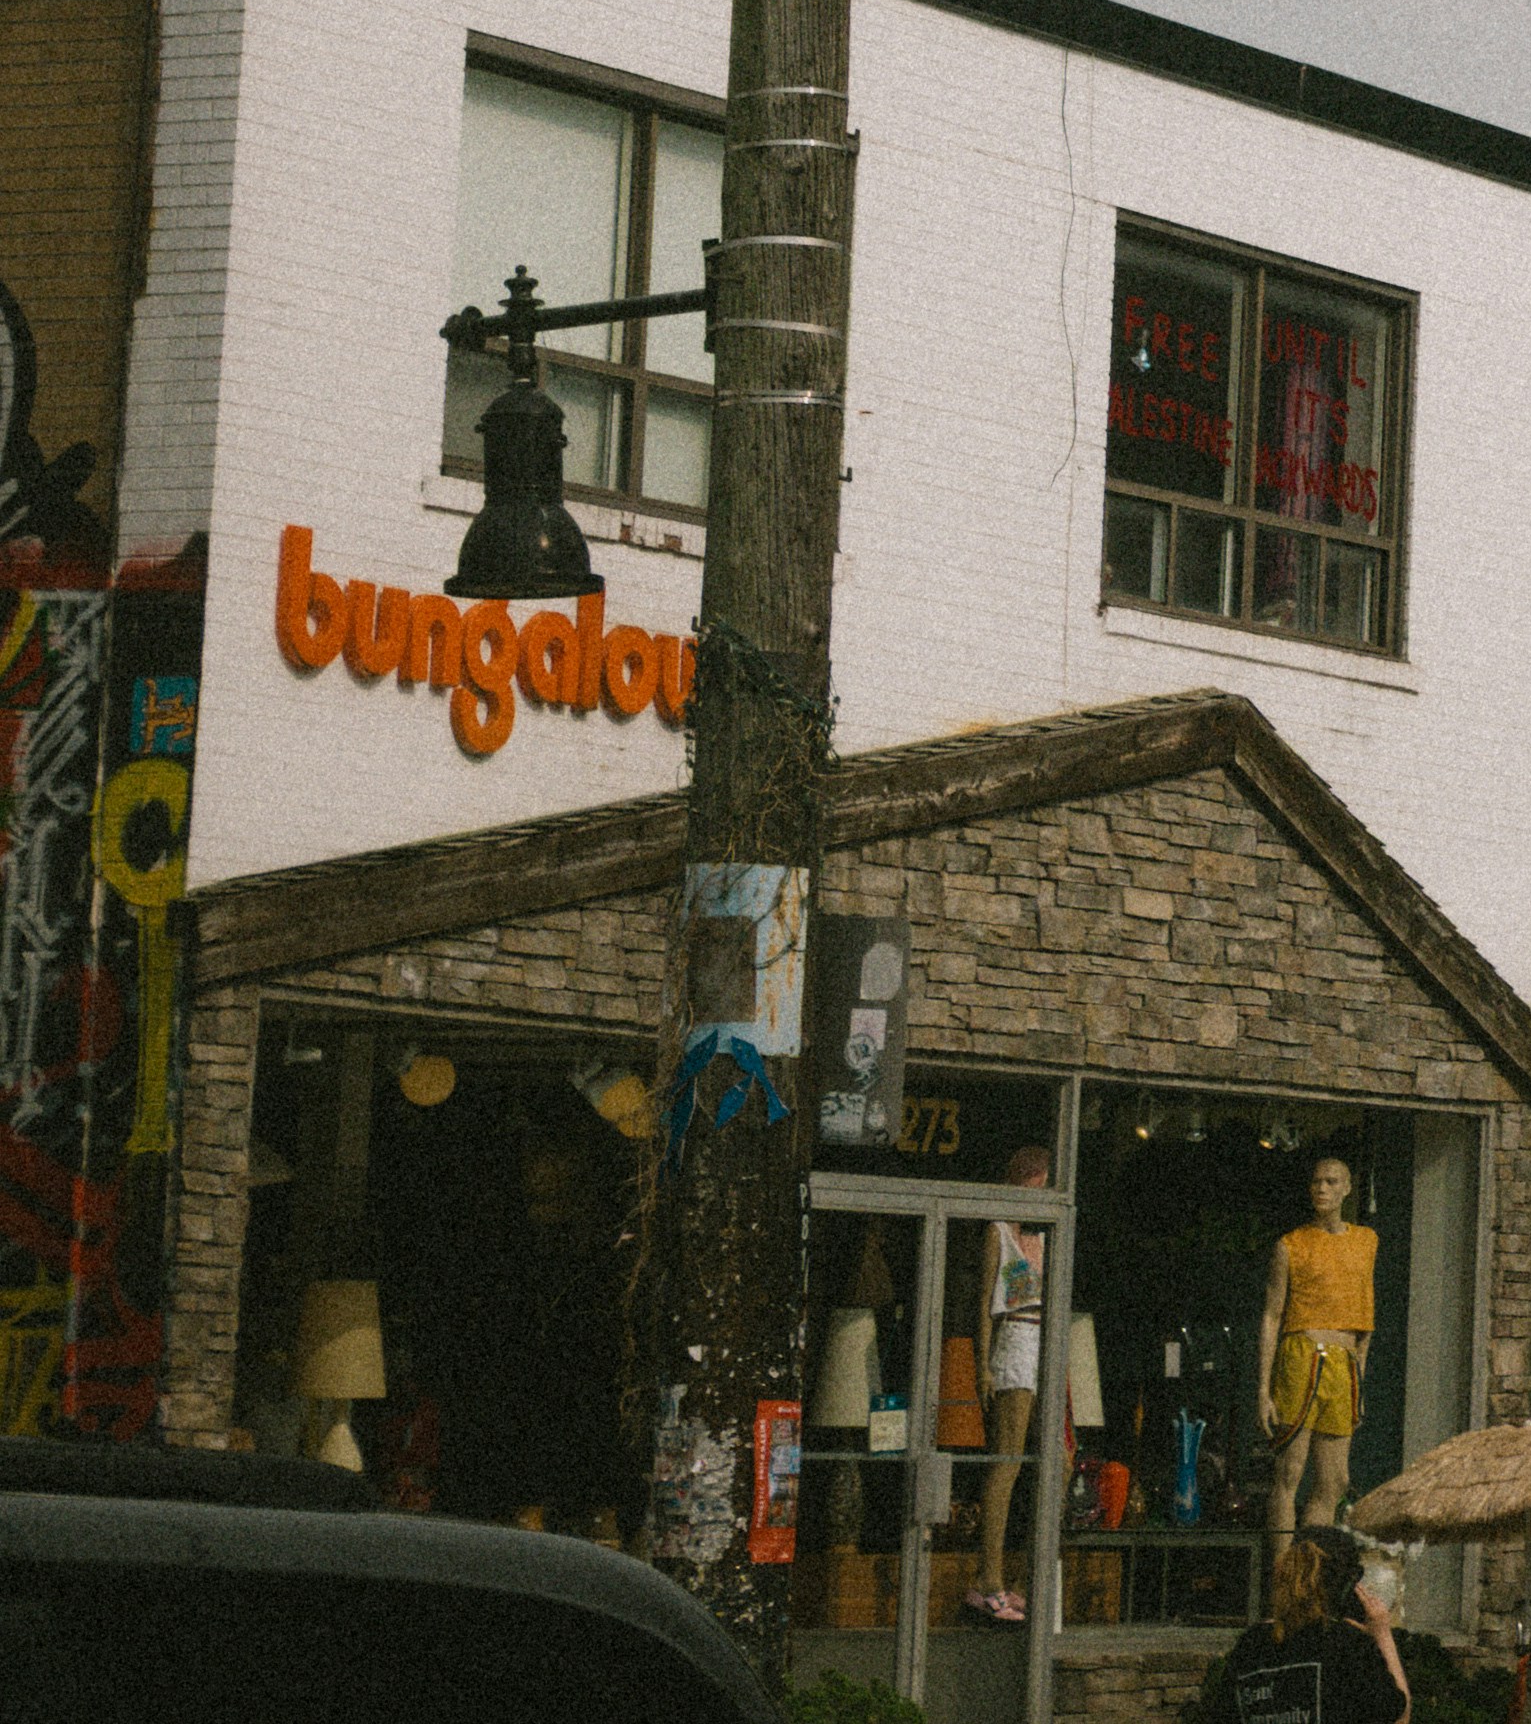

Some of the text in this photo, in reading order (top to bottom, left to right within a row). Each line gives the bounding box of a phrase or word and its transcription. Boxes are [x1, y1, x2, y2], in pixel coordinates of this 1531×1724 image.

[1123, 294, 1220, 383] FREE
[1262, 314, 1367, 390] UNTIL
[1109, 380, 1234, 467] ALESTINE
[1293, 387, 1350, 447] IT'S
[1256, 441, 1378, 522] ACKWARDS
[896, 1095, 962, 1155] 273
